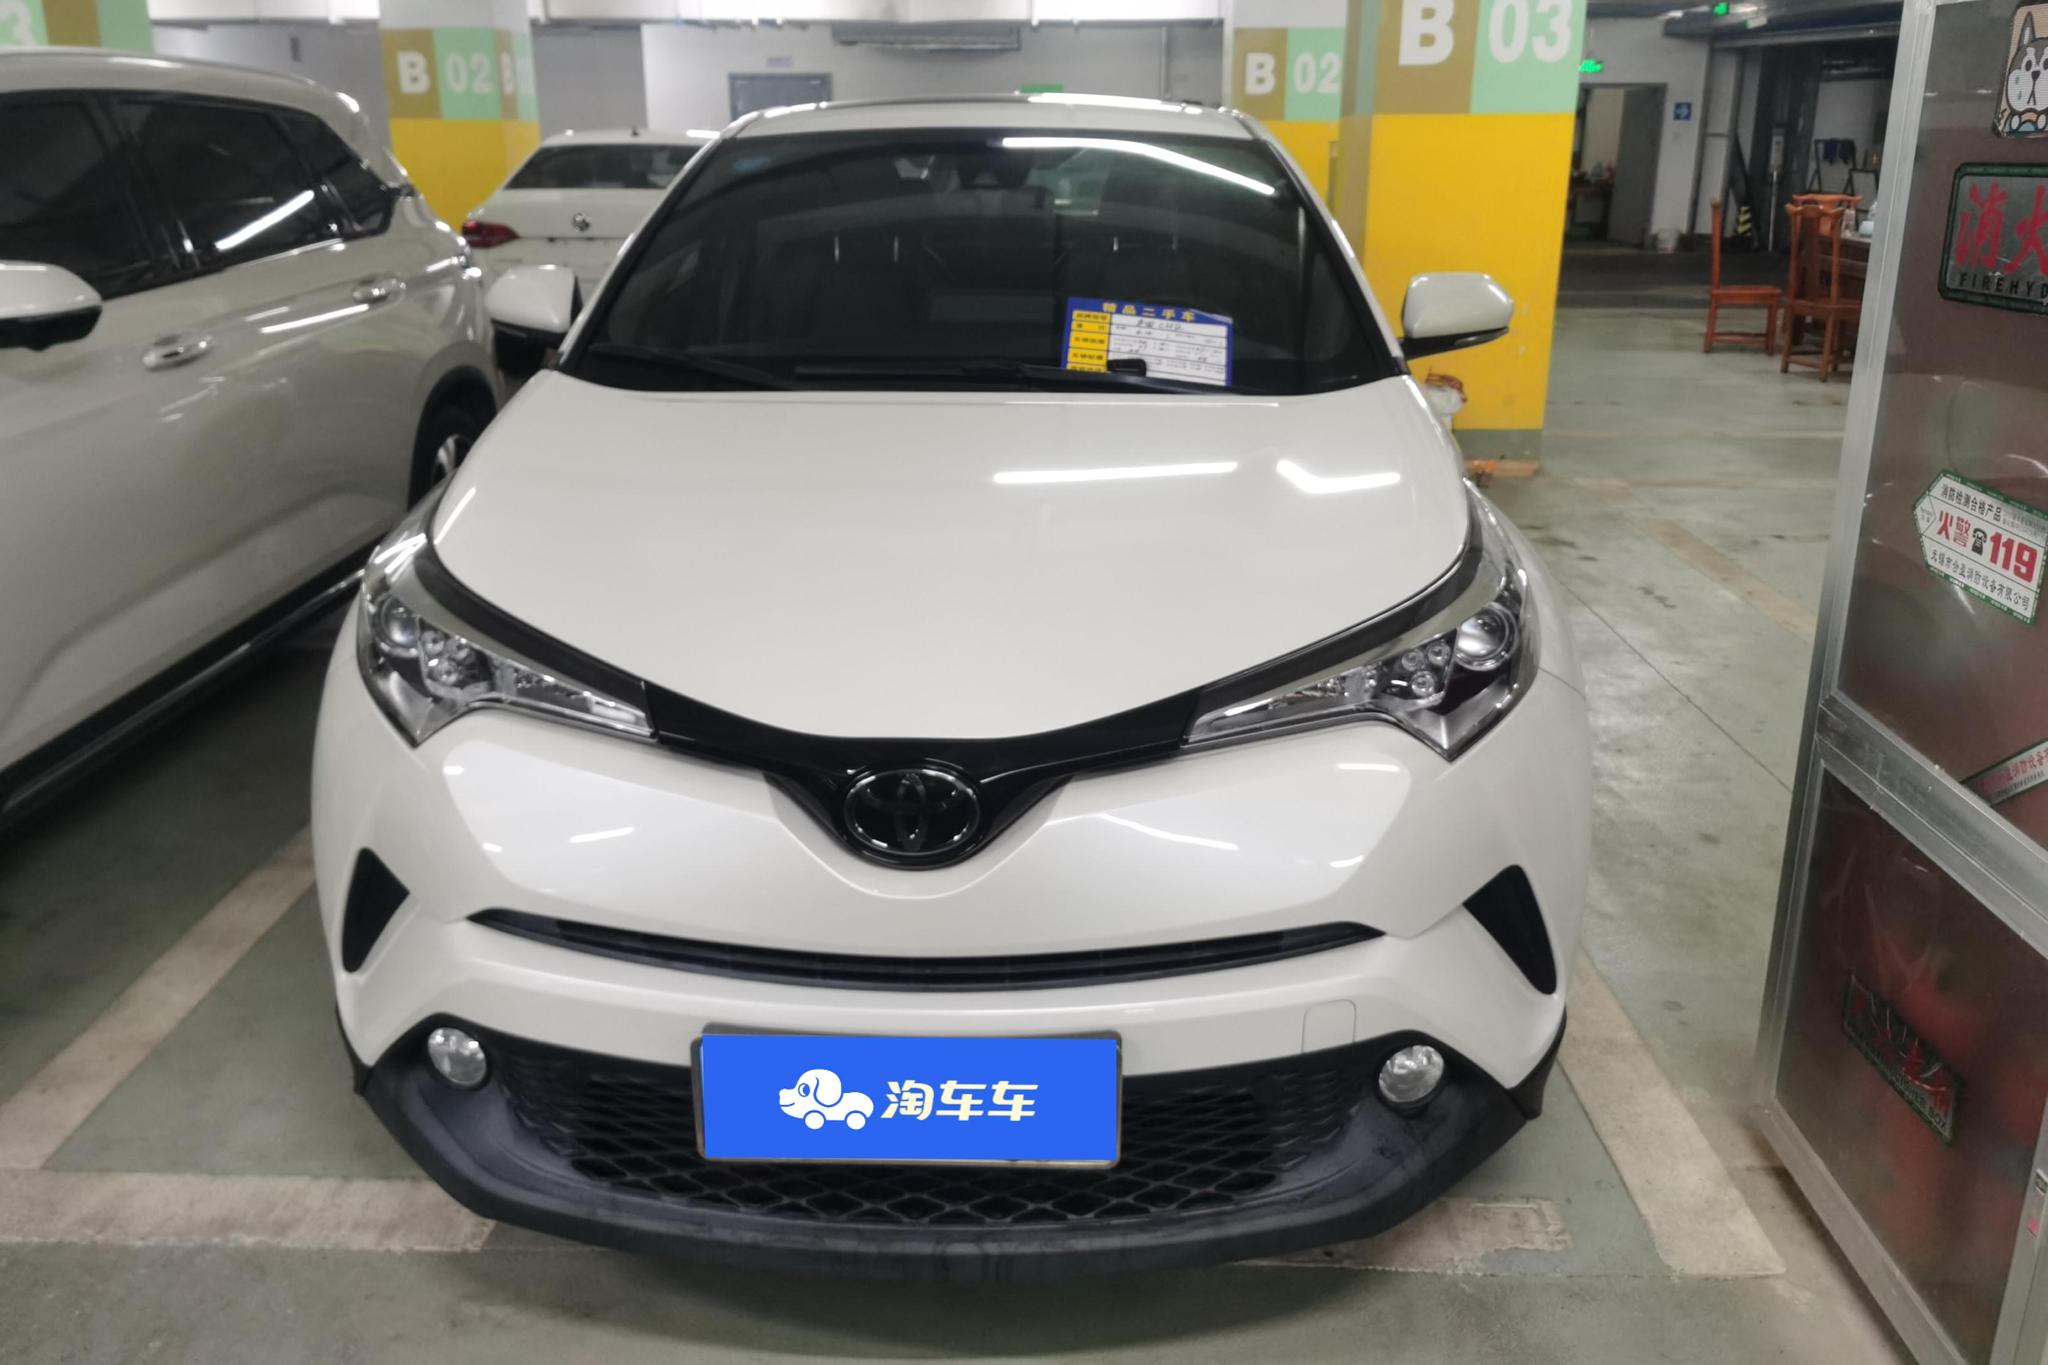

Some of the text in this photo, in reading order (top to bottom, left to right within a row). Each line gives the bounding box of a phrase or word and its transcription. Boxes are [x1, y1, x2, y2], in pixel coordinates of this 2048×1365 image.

[1398, 0, 1572, 65] B 03
[397, 50, 431, 94] B
[446, 52, 493, 94] 02
[1245, 52, 1341, 95] B 02
[1937, 509, 1972, 548] 火警
[1989, 531, 2038, 583] 119
